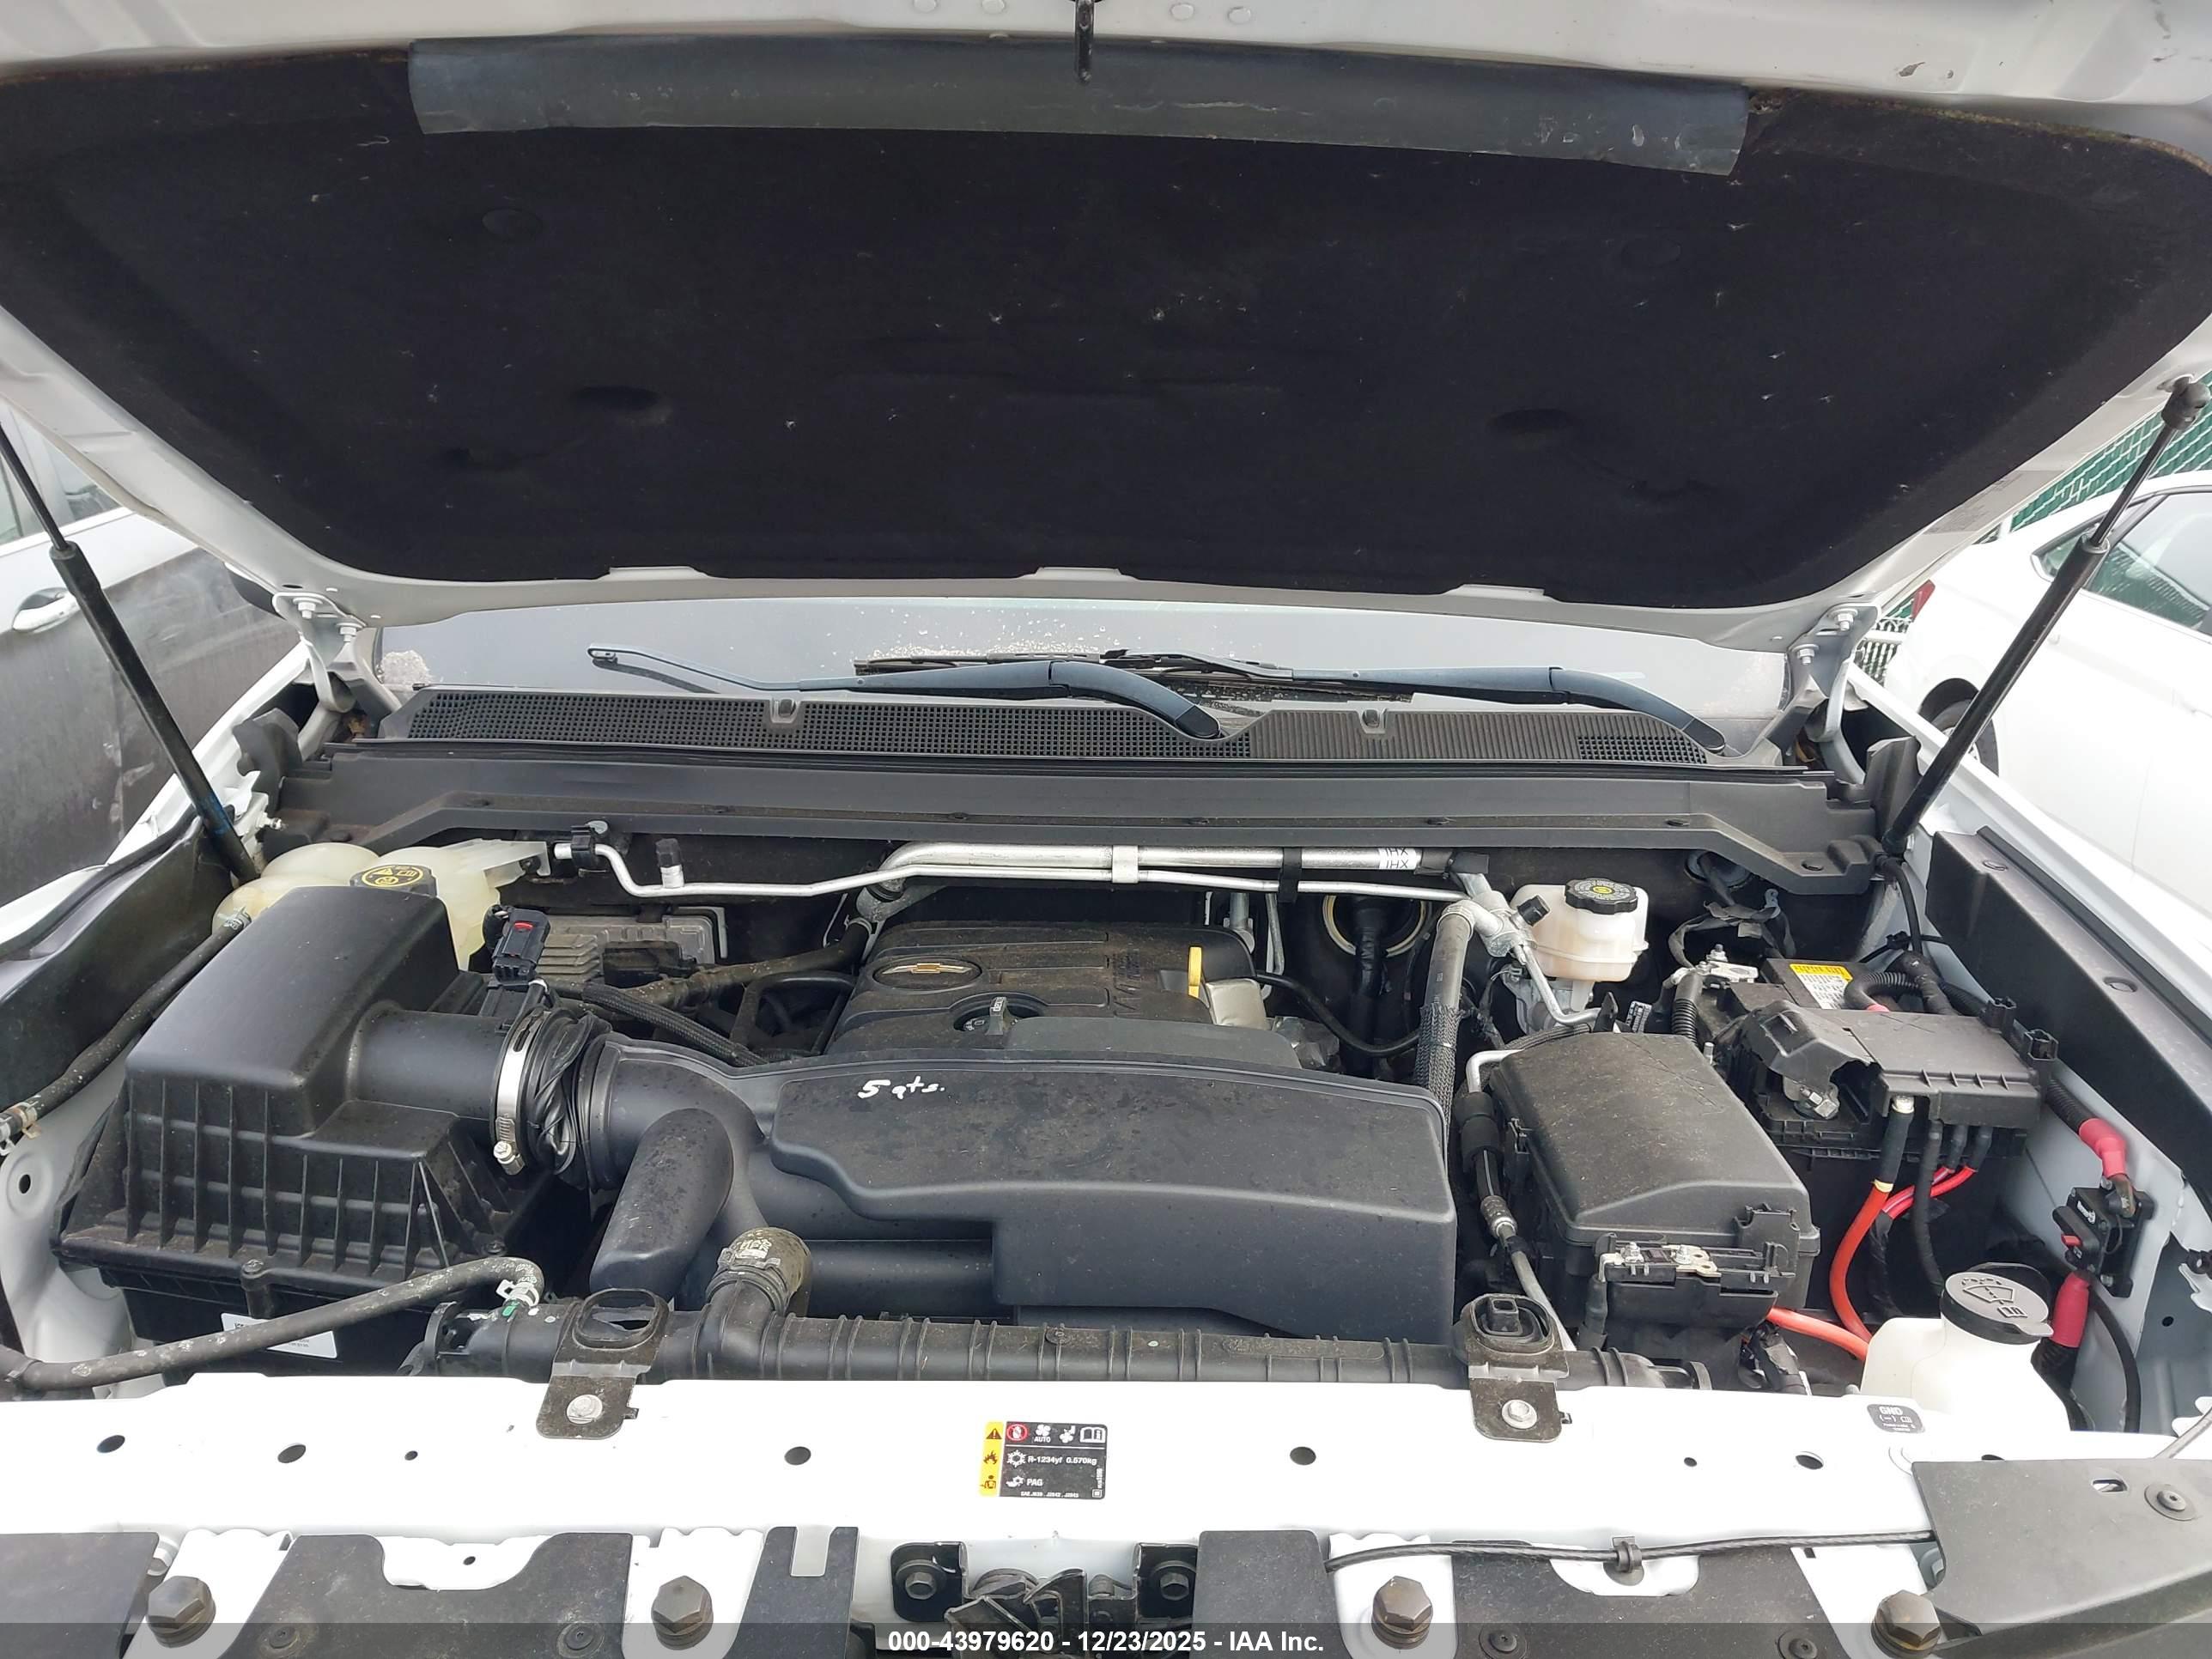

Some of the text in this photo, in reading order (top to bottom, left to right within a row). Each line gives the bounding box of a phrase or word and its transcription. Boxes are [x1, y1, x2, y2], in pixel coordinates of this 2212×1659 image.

[1386, 860, 1408, 868] IHX
[857, 1079, 891, 1099] 5
[1027, 1455, 1063, 1465] R-1234yf
[1026, 1478, 1043, 1486] PAG
